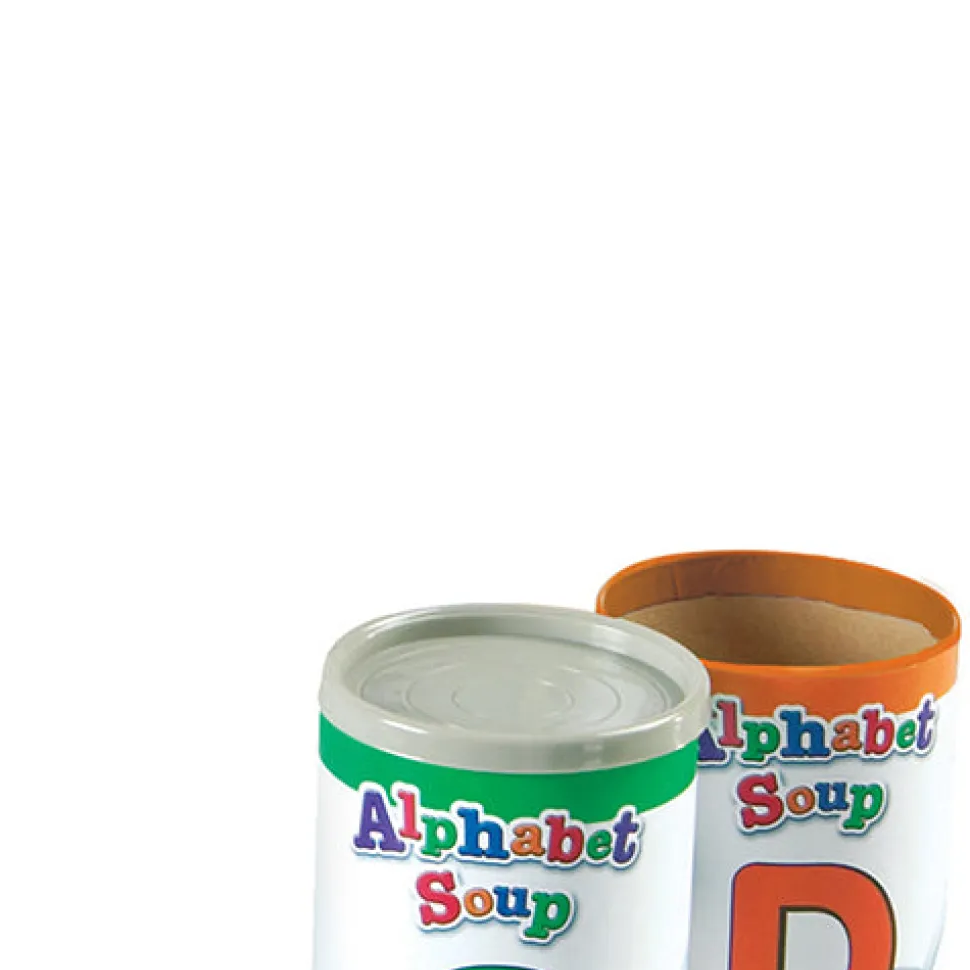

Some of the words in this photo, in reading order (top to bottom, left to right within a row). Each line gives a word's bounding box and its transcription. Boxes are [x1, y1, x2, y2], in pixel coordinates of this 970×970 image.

[353, 789, 641, 865] Alphabet
[736, 771, 885, 830] Soup
[415, 871, 571, 938] Soup
